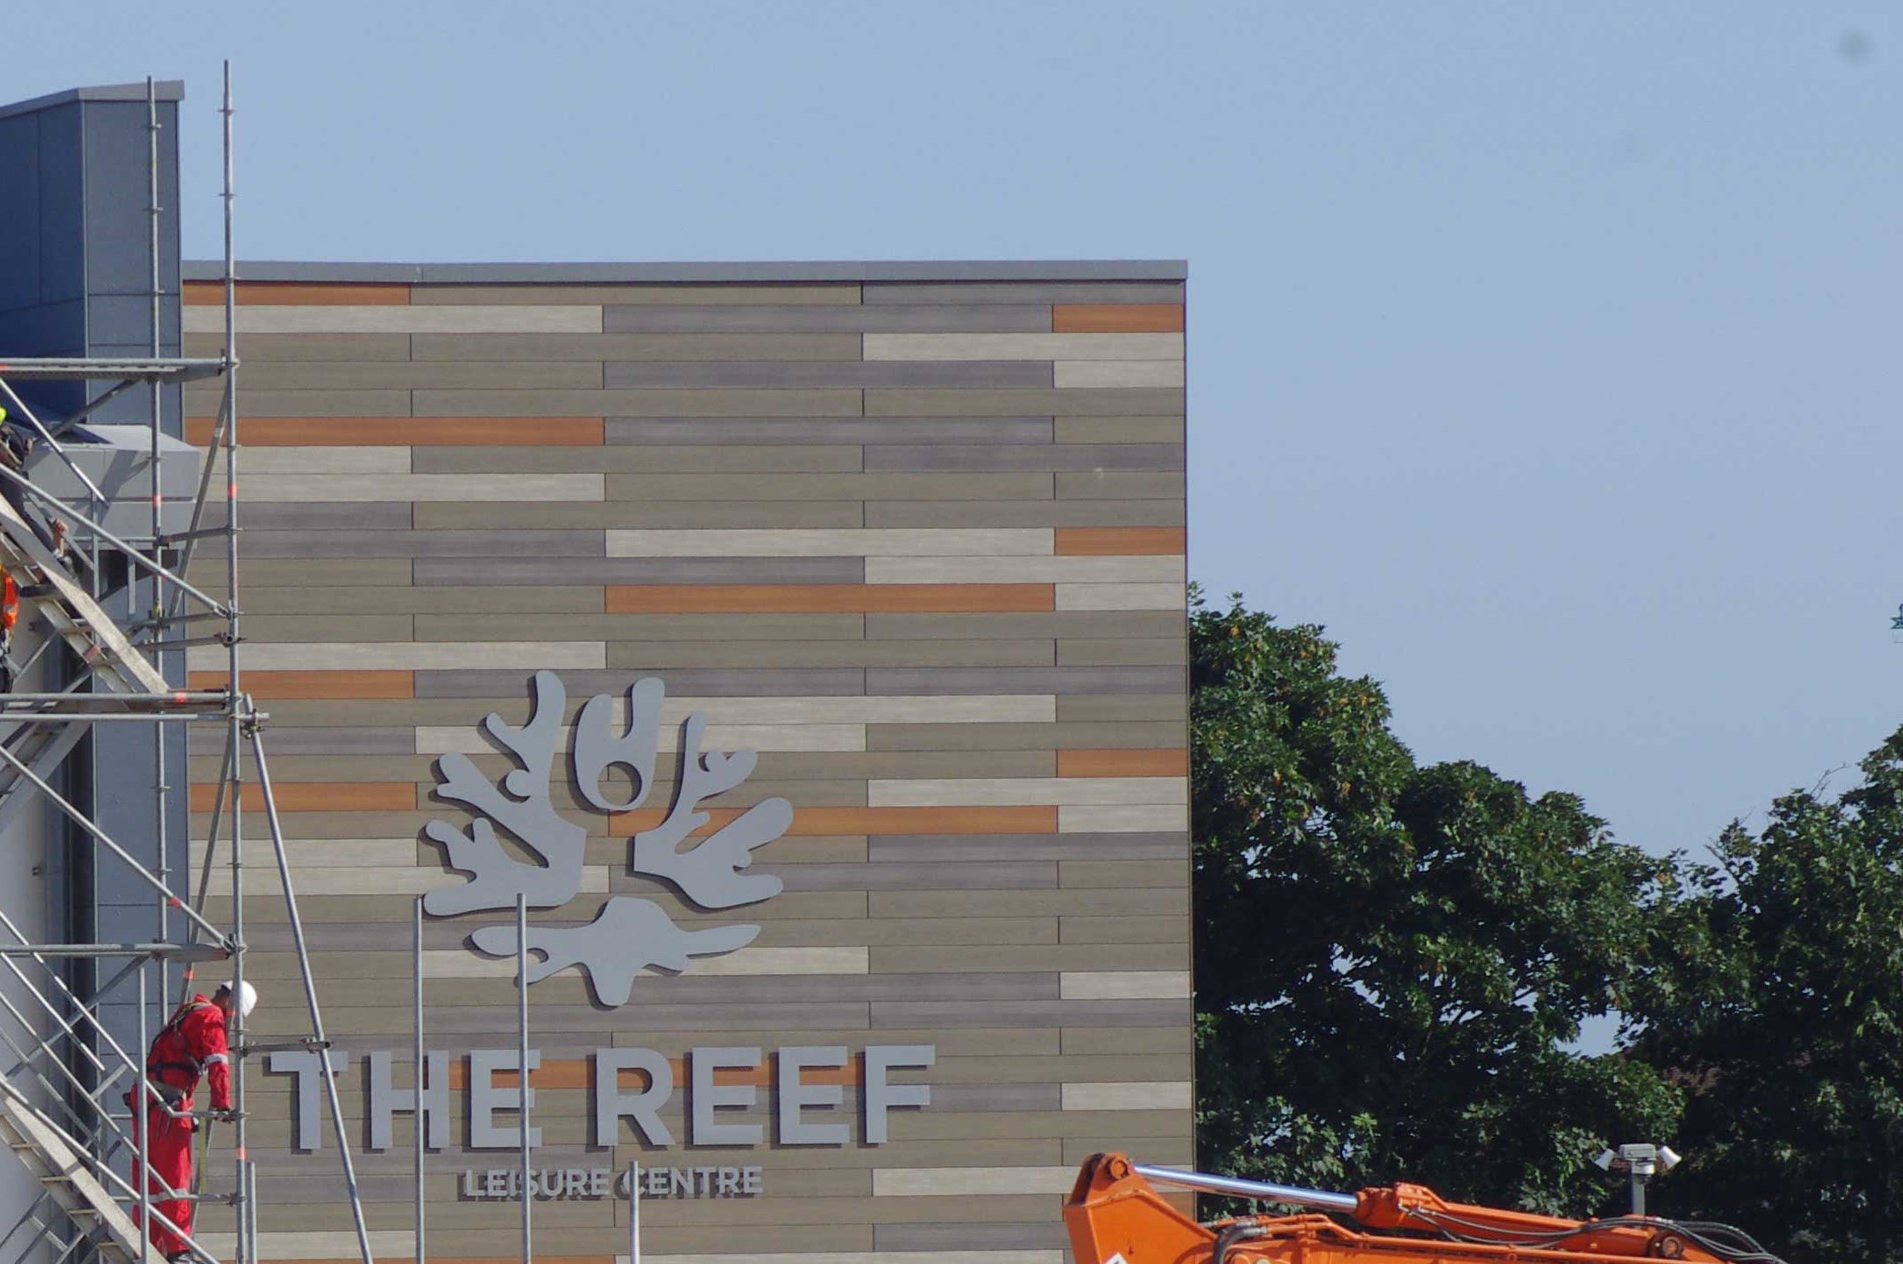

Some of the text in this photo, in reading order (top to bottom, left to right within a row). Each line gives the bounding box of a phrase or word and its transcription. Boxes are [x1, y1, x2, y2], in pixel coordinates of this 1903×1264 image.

[270, 1044, 936, 1150] THE REEF
[464, 1165, 765, 1197] LEISURE CENTRE
